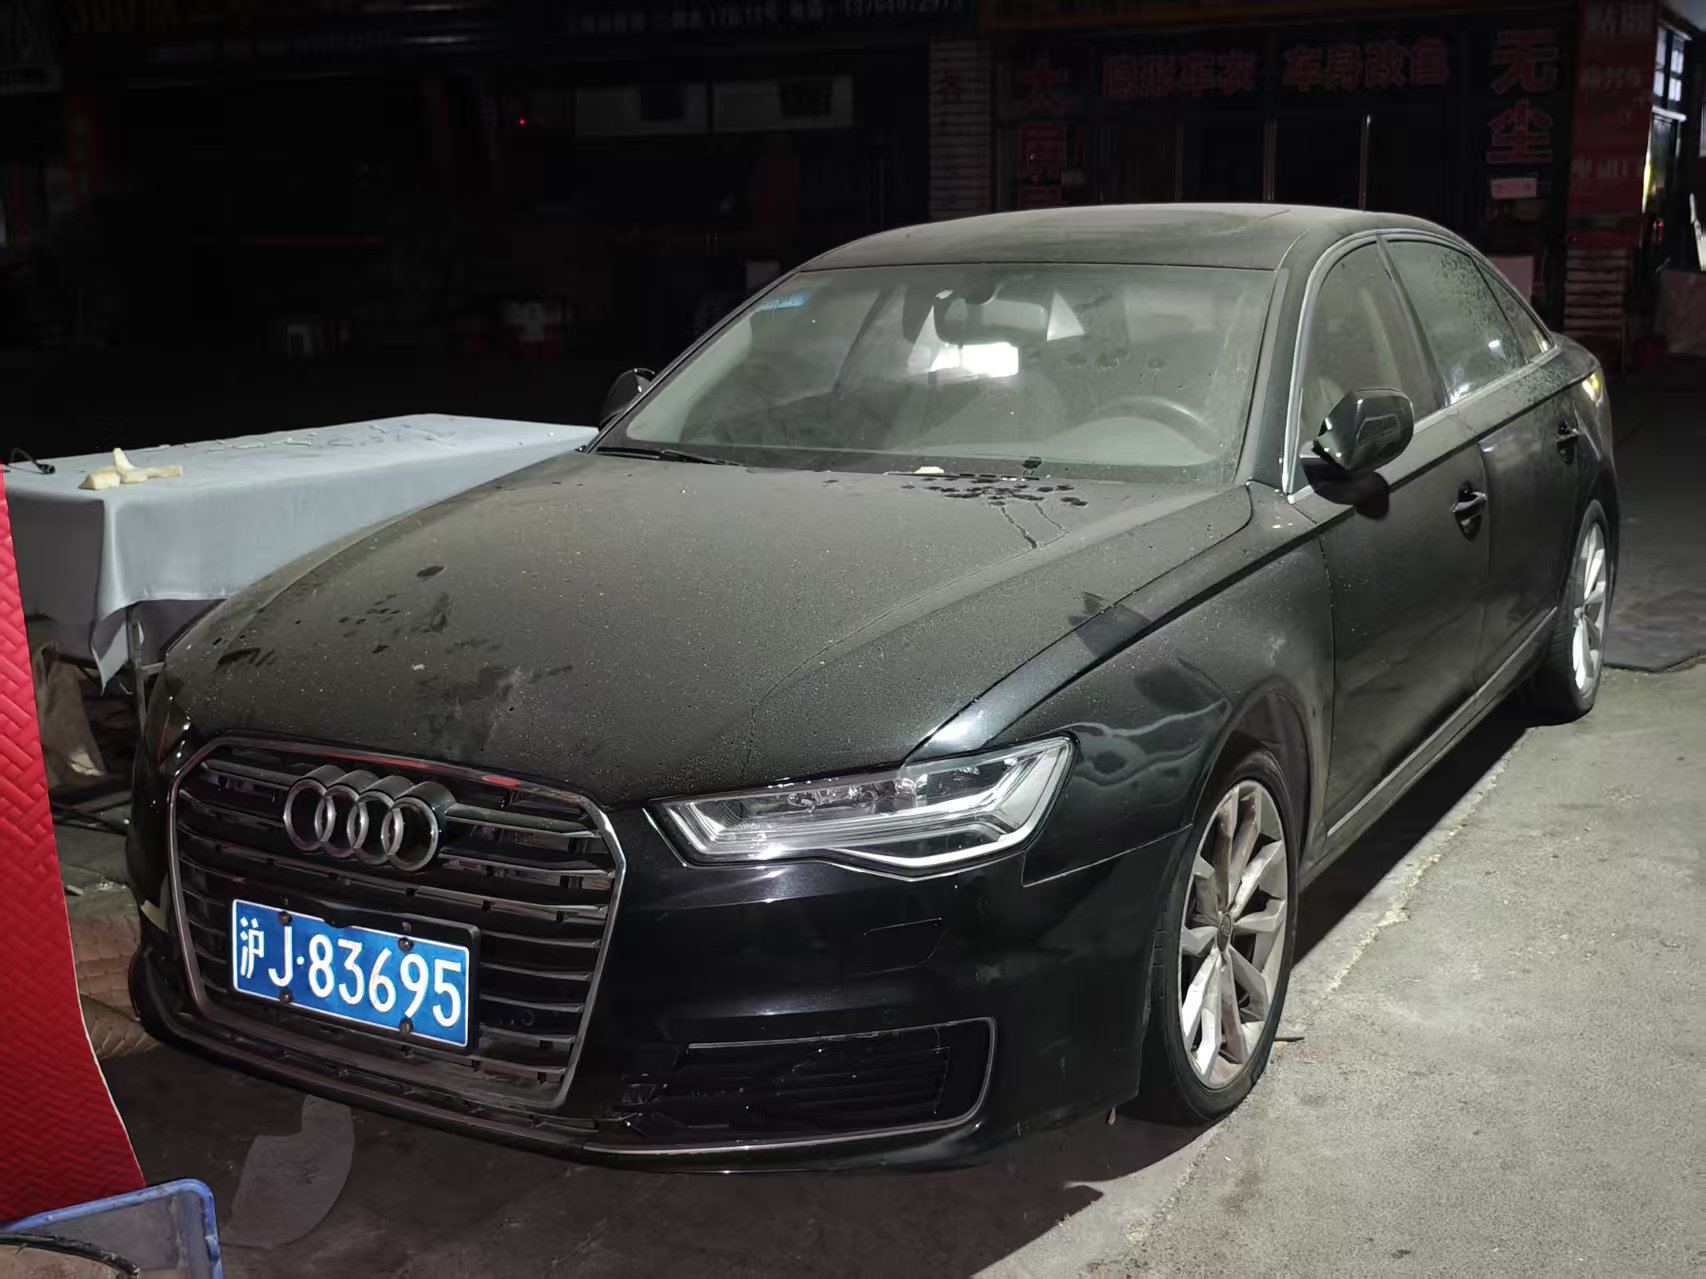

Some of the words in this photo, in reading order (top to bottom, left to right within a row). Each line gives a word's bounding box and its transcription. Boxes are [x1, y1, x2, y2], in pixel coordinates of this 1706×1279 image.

[1281, 37, 1451, 91] 车身改色
[1488, 30, 1560, 165] 无尘
